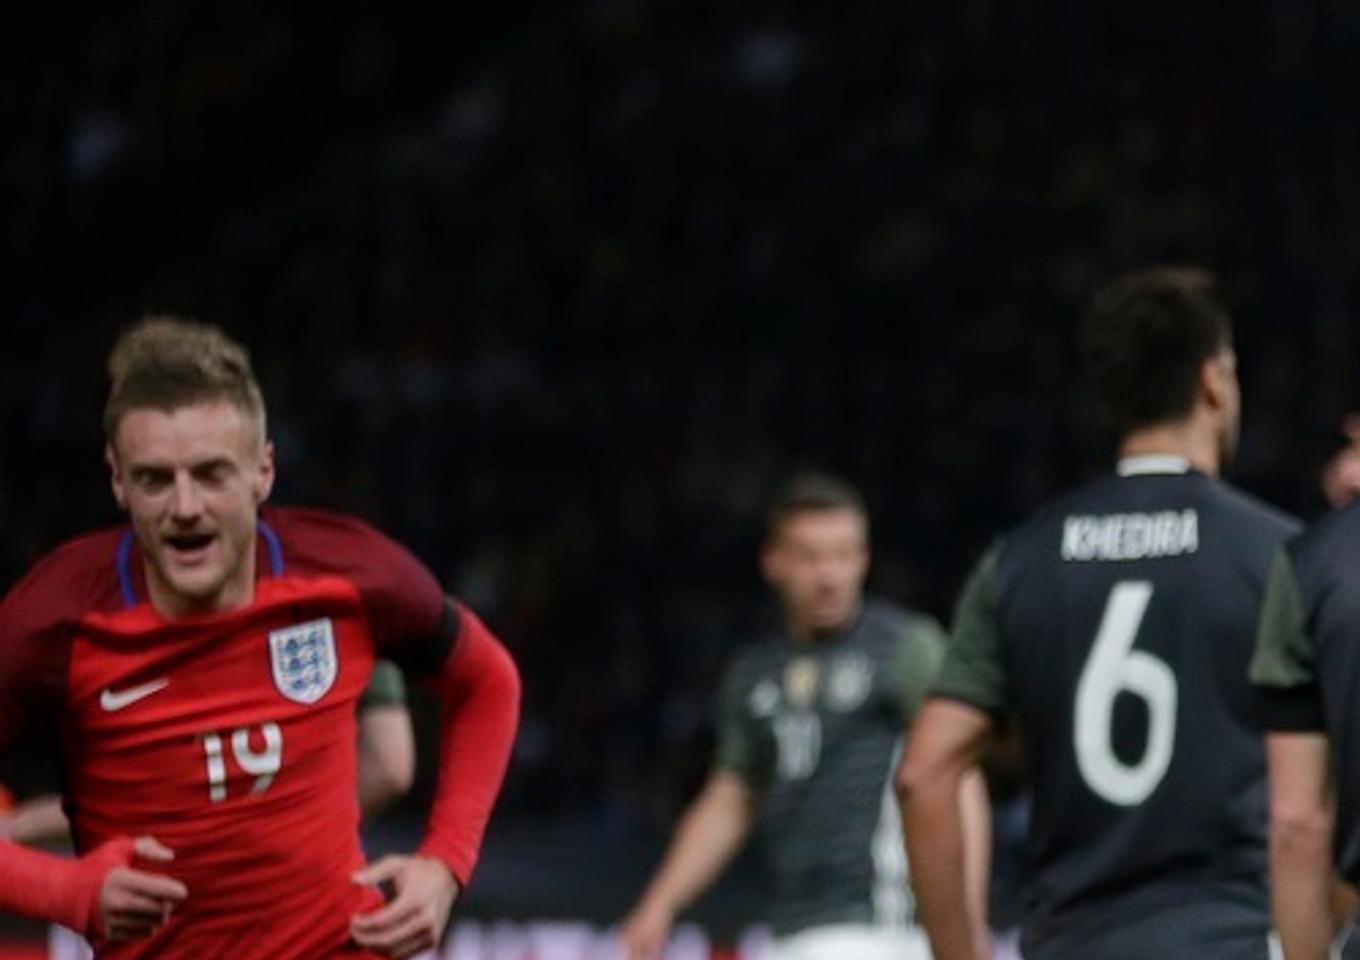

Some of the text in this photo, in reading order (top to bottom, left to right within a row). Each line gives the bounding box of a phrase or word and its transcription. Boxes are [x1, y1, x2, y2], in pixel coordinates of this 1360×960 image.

[1061, 509, 1199, 561] KHEDIRA
[1073, 580, 1178, 806] 6
[203, 722, 283, 802] 19
